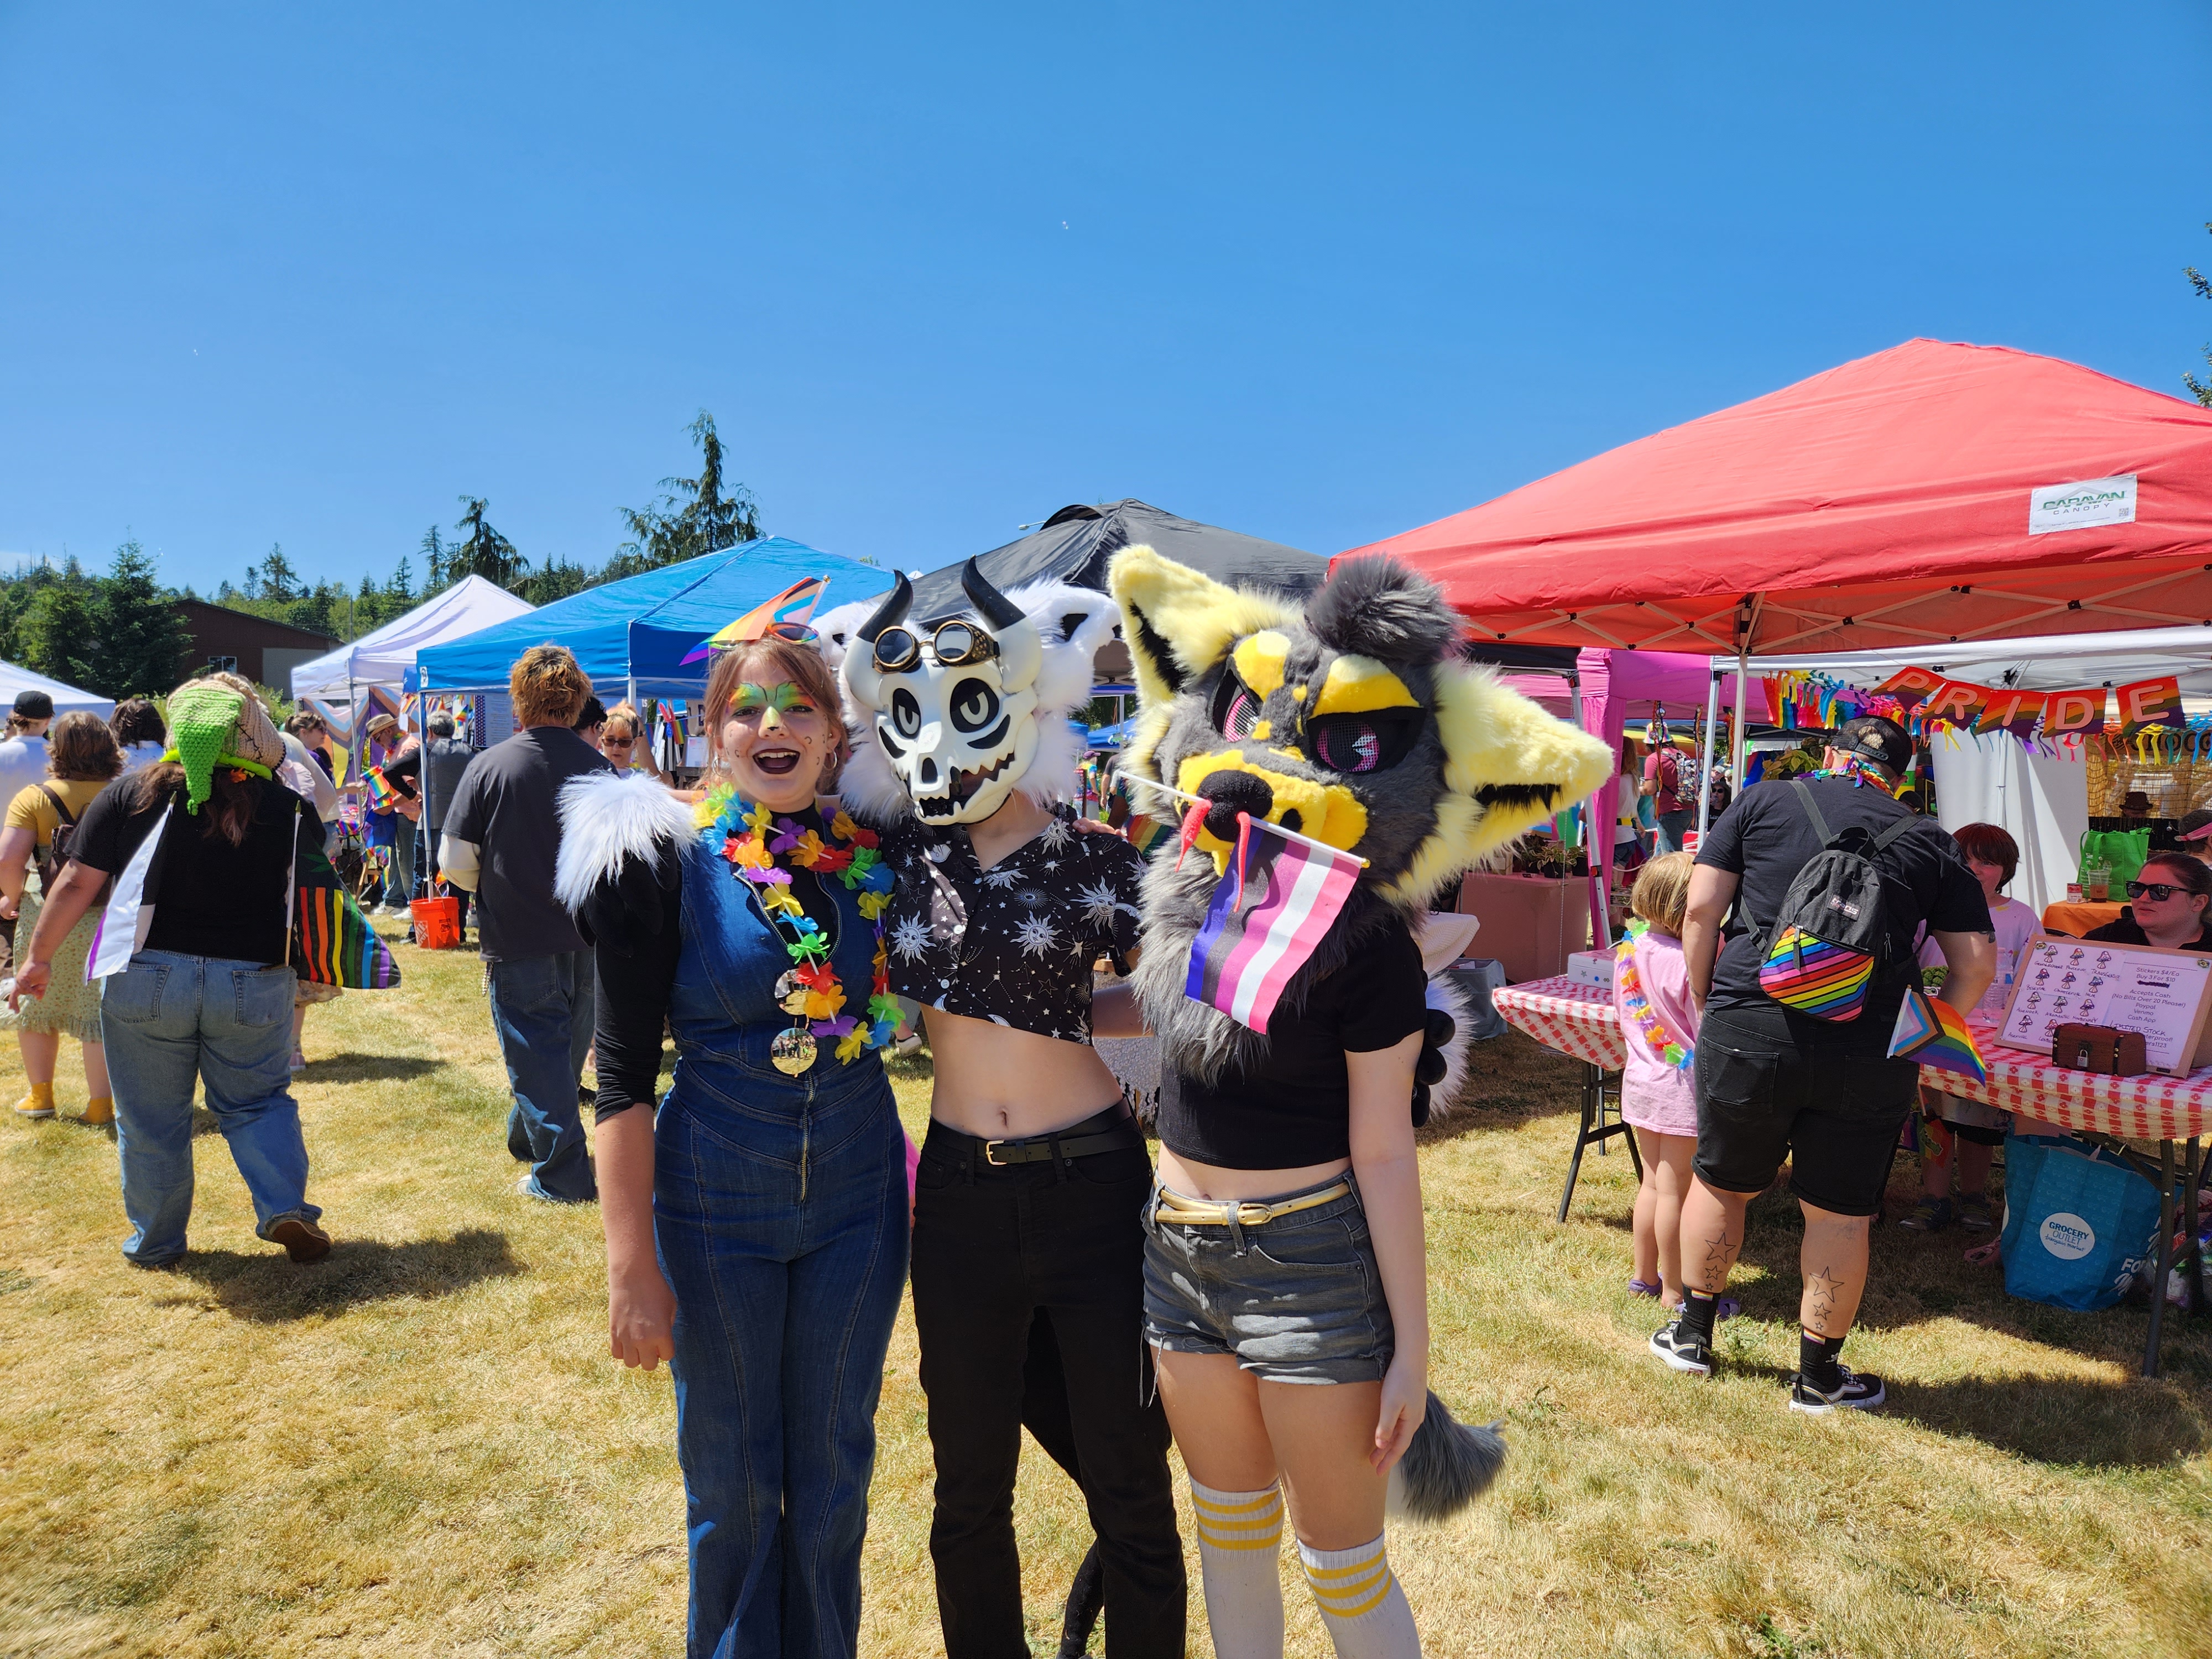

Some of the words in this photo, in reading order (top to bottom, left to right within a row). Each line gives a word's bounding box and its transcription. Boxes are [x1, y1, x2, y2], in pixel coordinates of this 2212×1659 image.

[2043, 491, 2125, 510] CARAVAN
[2053, 503, 2110, 515] CANOPY
[1887, 671, 2170, 729] PRIDE
[2161, 999, 2186, 1008] Please!)
[2143, 1026, 2166, 1036] STOCK
[2049, 1221, 2090, 1240] GROCERY
[2052, 1230, 2082, 1245] OUTLET
[2044, 1233, 2067, 1246] bargain
[2067, 1243, 2085, 1251] market
